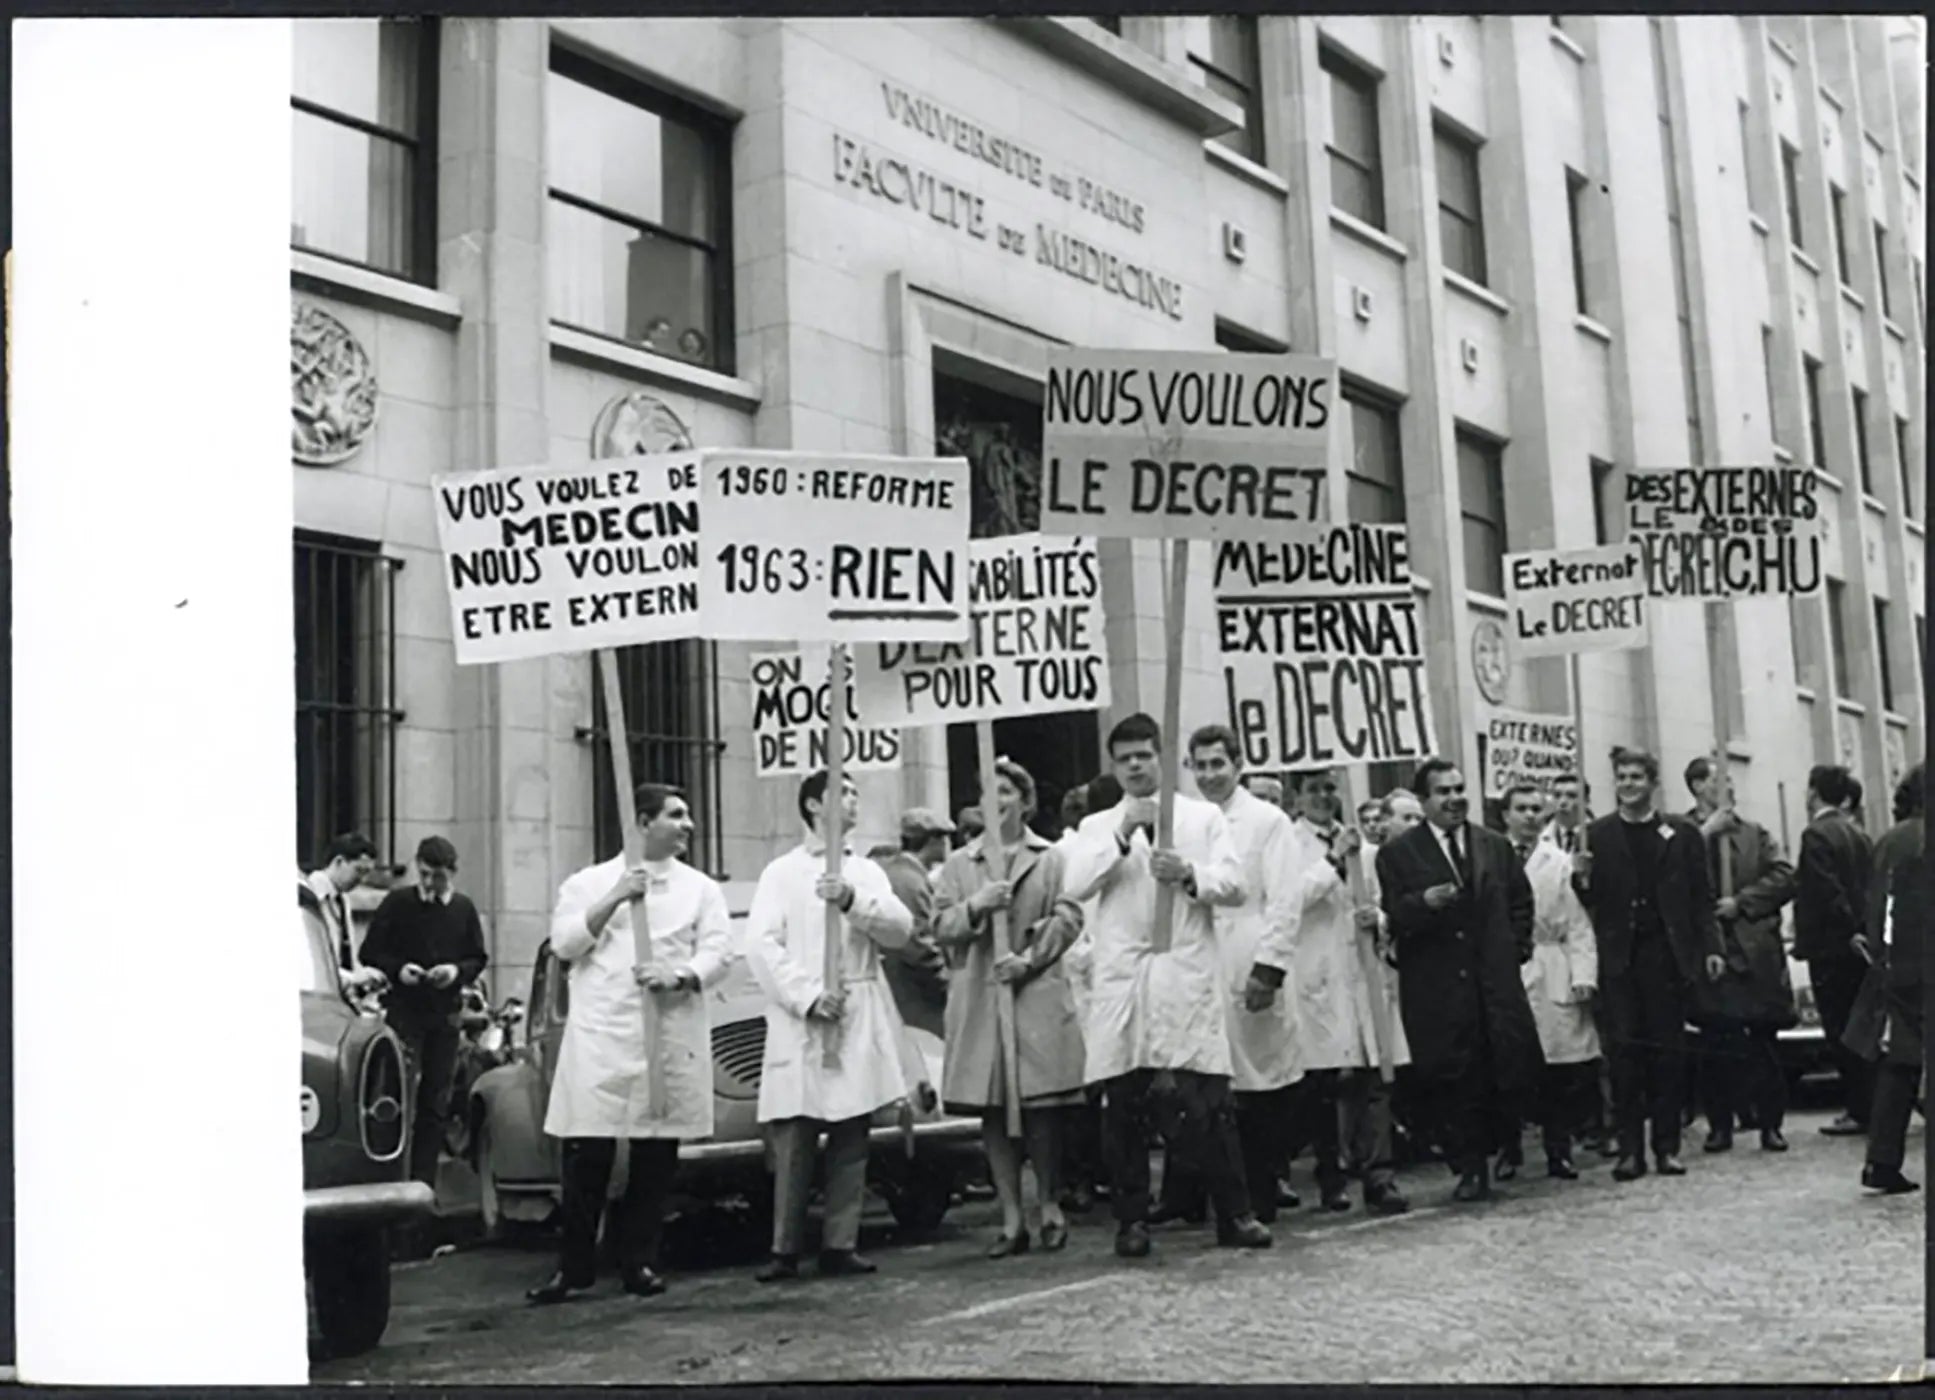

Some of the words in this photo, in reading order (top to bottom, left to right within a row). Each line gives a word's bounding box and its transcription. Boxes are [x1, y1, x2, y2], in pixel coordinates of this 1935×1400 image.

[1078, 177, 1144, 235] PARIS
[1036, 223, 1182, 322] MEDECINE
[1048, 366, 1142, 426] NOUS
[1149, 370, 1329, 430] VOULONS
[442, 476, 525, 522] VOUS
[536, 469, 640, 506] VOULEZ
[812, 469, 955, 509] REFORME
[1048, 457, 1109, 514] LE
[1131, 458, 1328, 522] DECRET
[1625, 473, 1672, 503] DES
[1673, 467, 1818, 521] EXTERNES
[1631, 505, 1674, 530] LE
[451, 547, 542, 590] NOUS
[830, 543, 956, 604] RIEN
[1213, 524, 1411, 589] MEDECINE
[462, 601, 552, 639] ETRE
[1218, 602, 1420, 657] EXTERNAT
[1517, 607, 1548, 638] Le
[1552, 593, 1644, 634] DECRET
[752, 656, 802, 686] ON
[903, 662, 1002, 714] POUR
[1014, 655, 1103, 703] TOUS
[1274, 659, 1433, 763] DECRET
[1489, 719, 1577, 751] EXTERNES
[760, 730, 797, 769] DE
